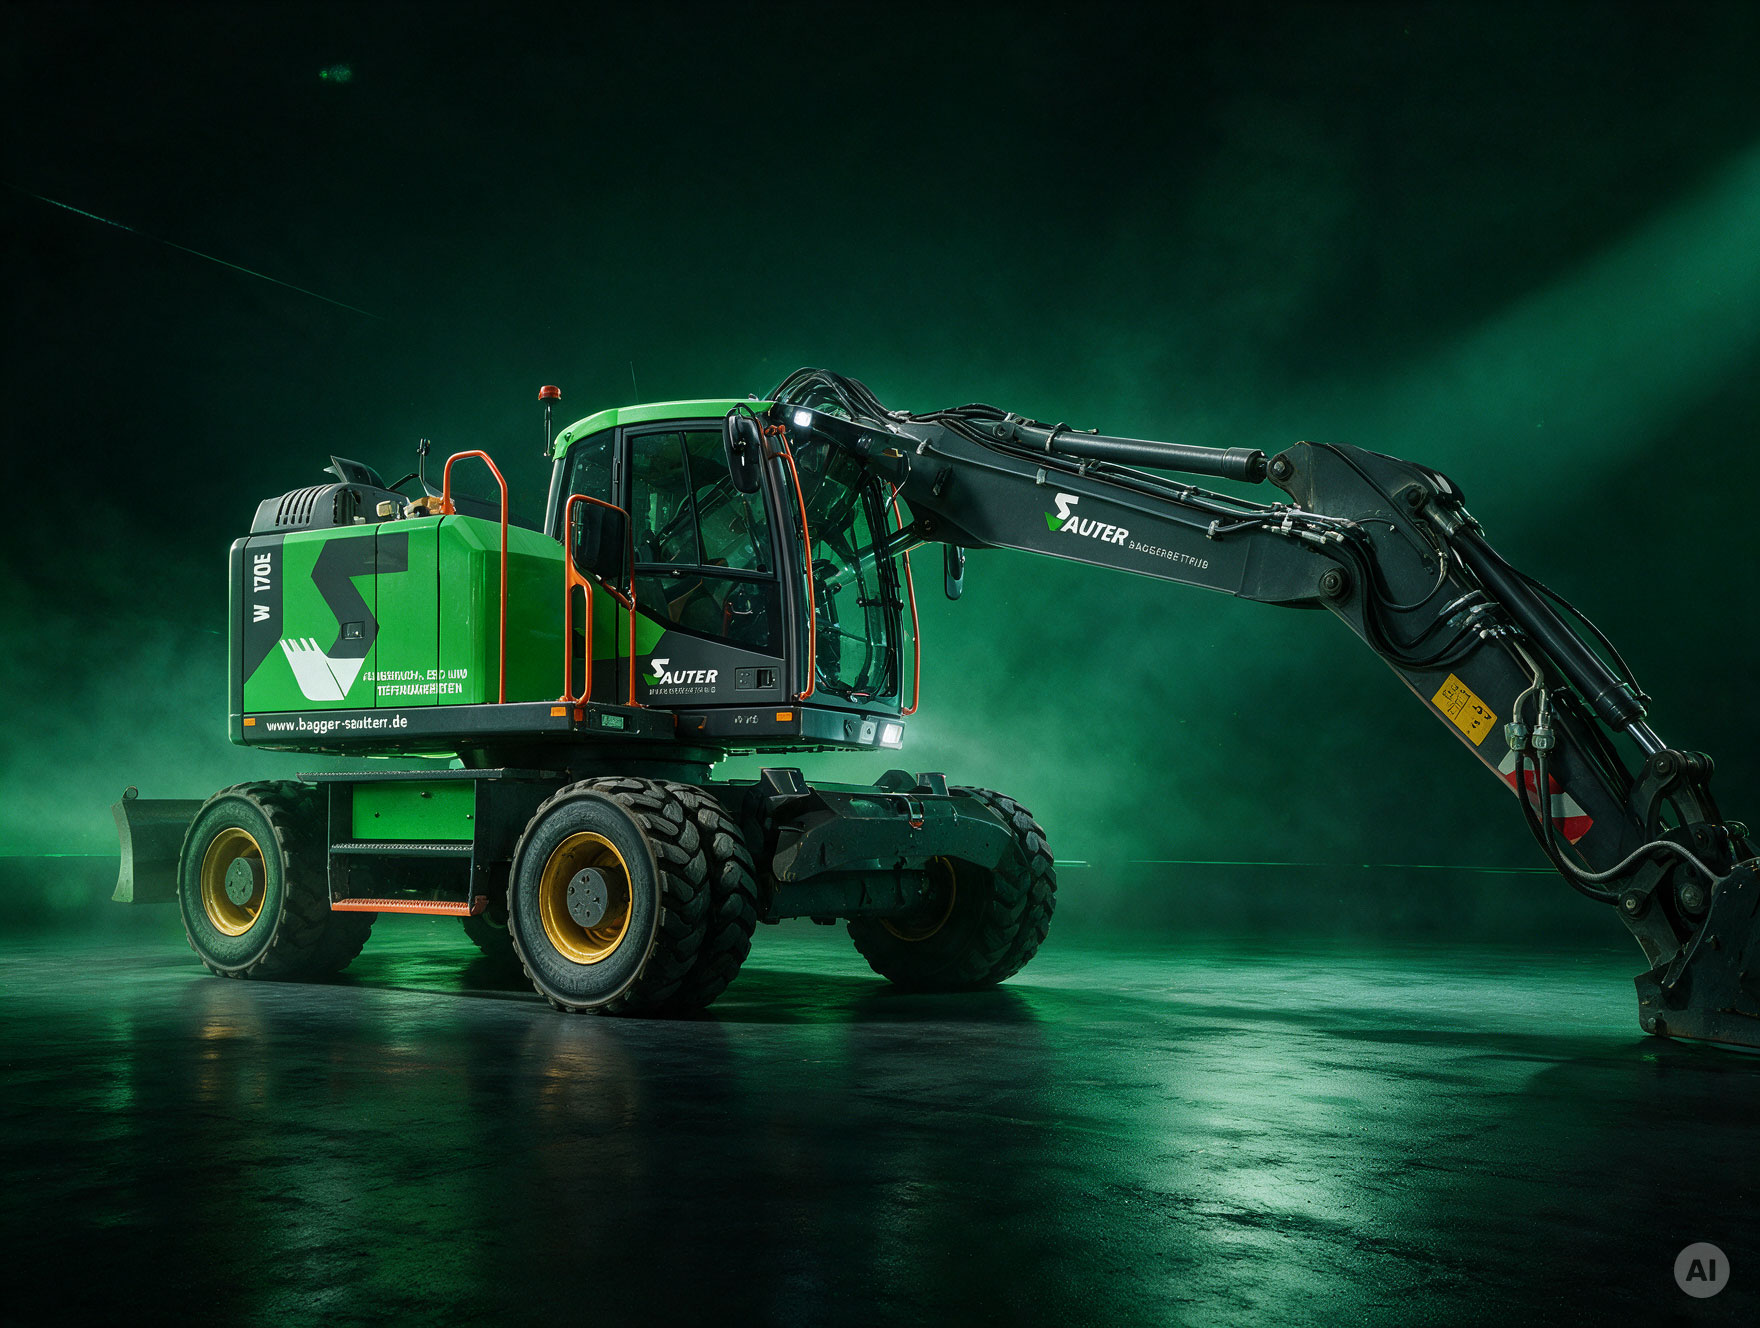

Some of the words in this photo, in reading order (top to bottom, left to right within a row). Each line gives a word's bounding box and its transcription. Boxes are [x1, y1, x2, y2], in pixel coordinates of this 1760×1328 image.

[1054, 492, 1129, 546] SAUTER
[253, 552, 271, 593] 170E
[253, 604, 270, 623] W
[650, 658, 718, 685] SAUTER
